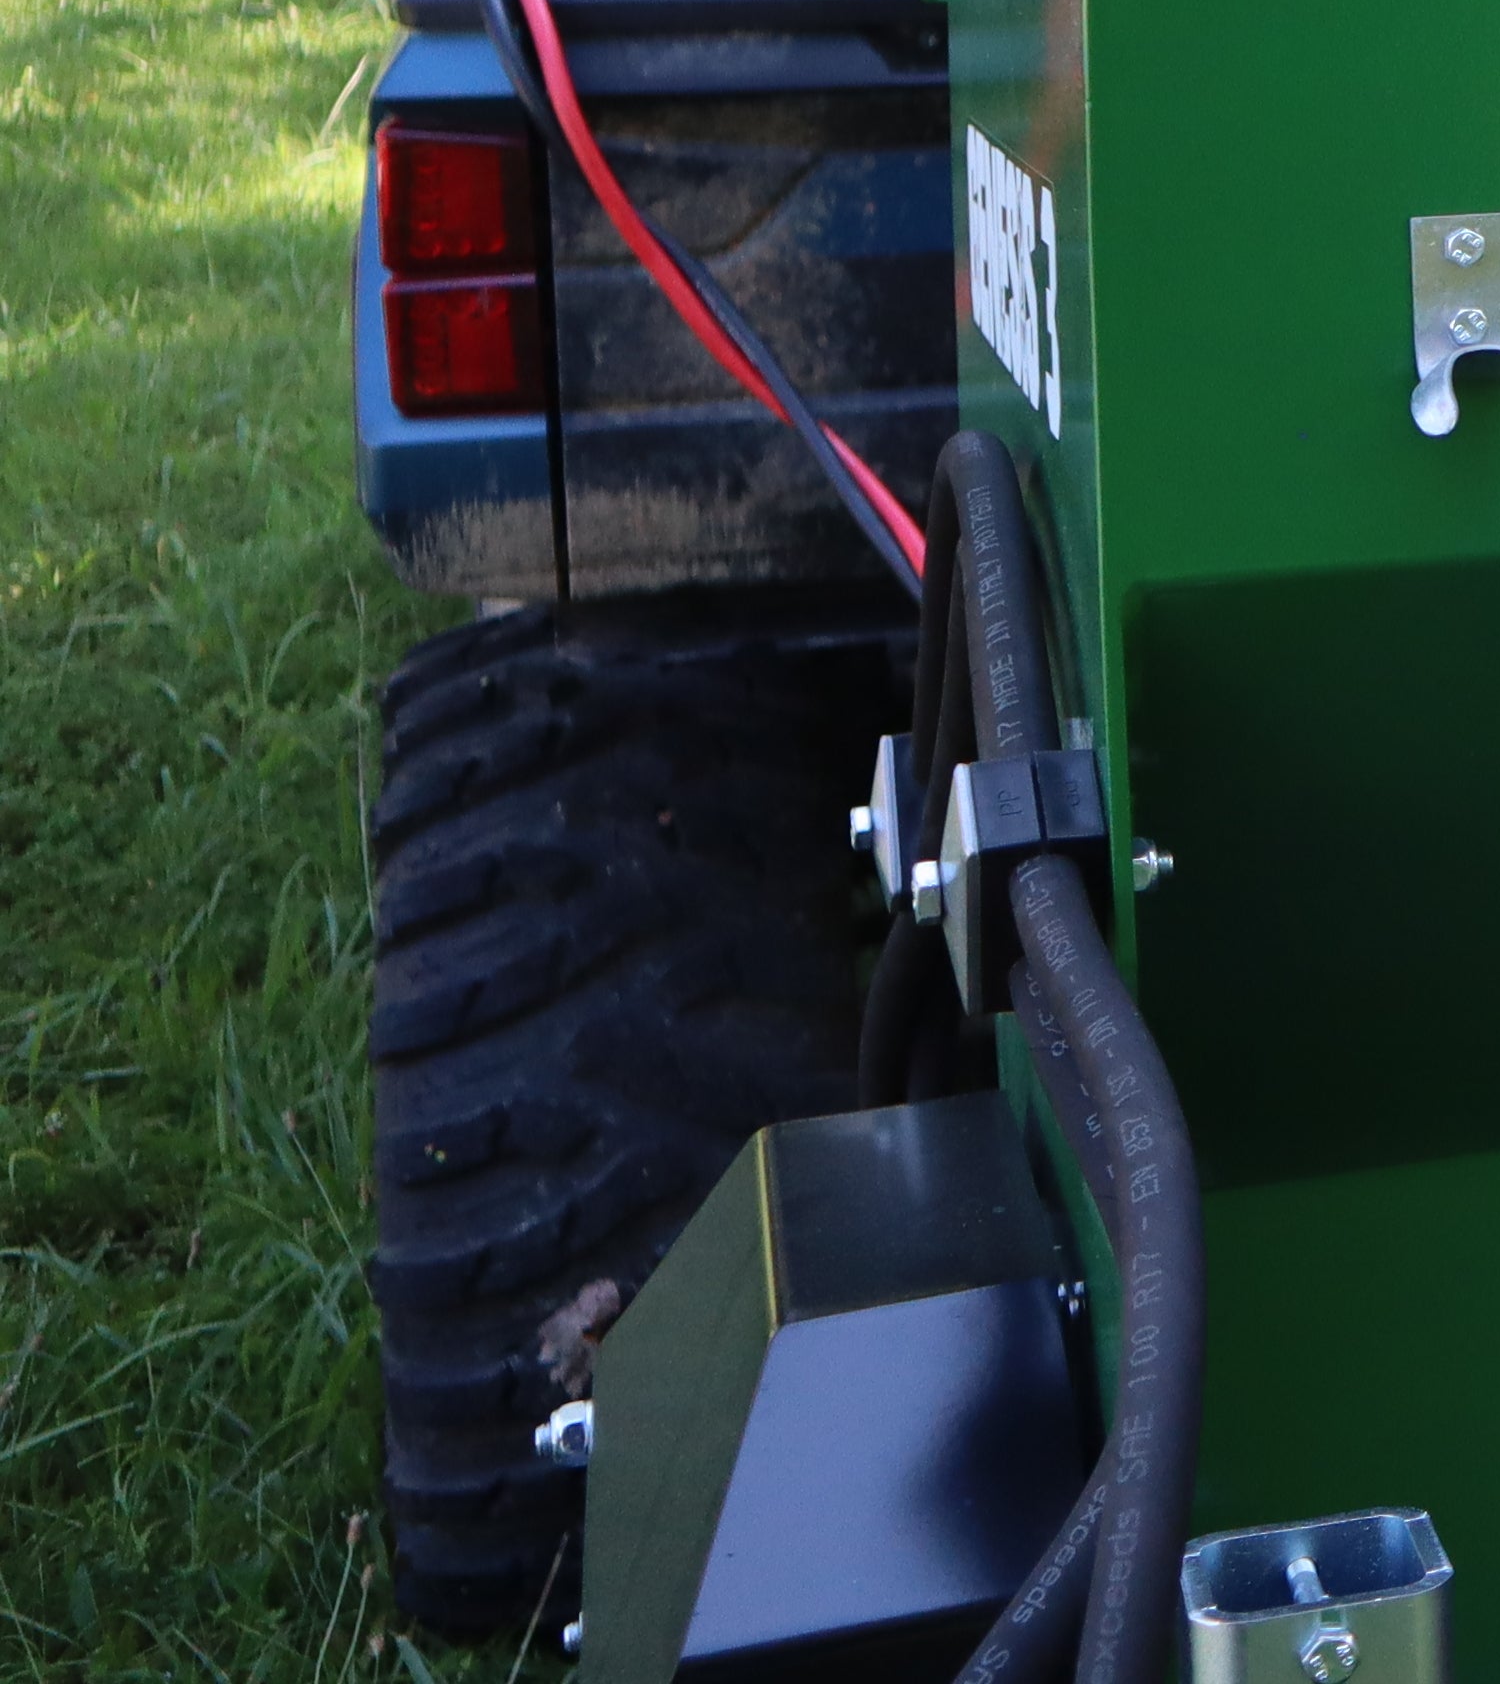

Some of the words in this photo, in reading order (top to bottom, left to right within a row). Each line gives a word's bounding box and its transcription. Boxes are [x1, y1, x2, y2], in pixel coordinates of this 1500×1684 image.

[976, 557, 1008, 616] ITALY
[983, 619, 1012, 651] IN
[989, 653, 1020, 716] MADE
[1129, 1163, 1162, 1205] EN
[1131, 1252, 1163, 1310] R17
[1128, 1324, 1162, 1389] 100
[1115, 1412, 1154, 1484] SAE
